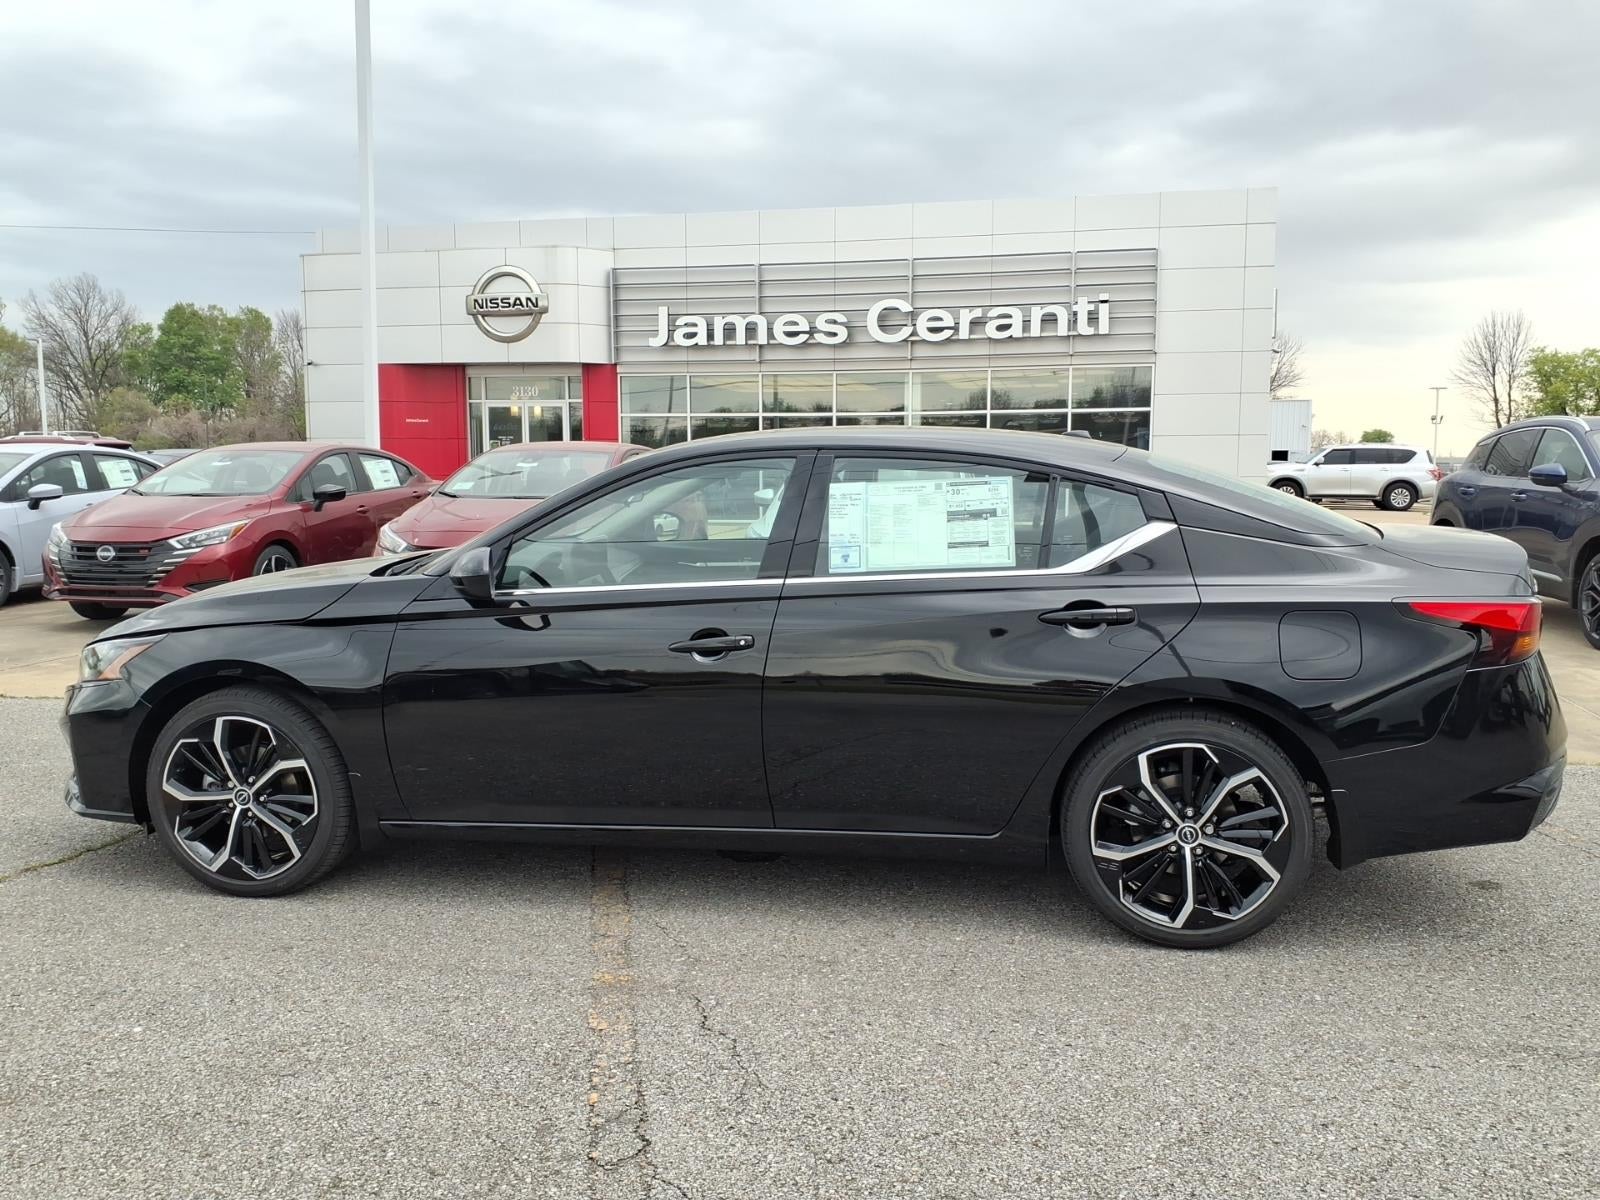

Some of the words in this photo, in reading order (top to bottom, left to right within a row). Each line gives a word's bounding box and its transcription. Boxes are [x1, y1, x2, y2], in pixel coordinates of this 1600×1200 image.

[473, 296, 539, 310] NISSAN
[648, 305, 849, 348] James
[866, 293, 1111, 343] Ceranti
[512, 386, 539, 397] 3130
[950, 488, 961, 496] 30
